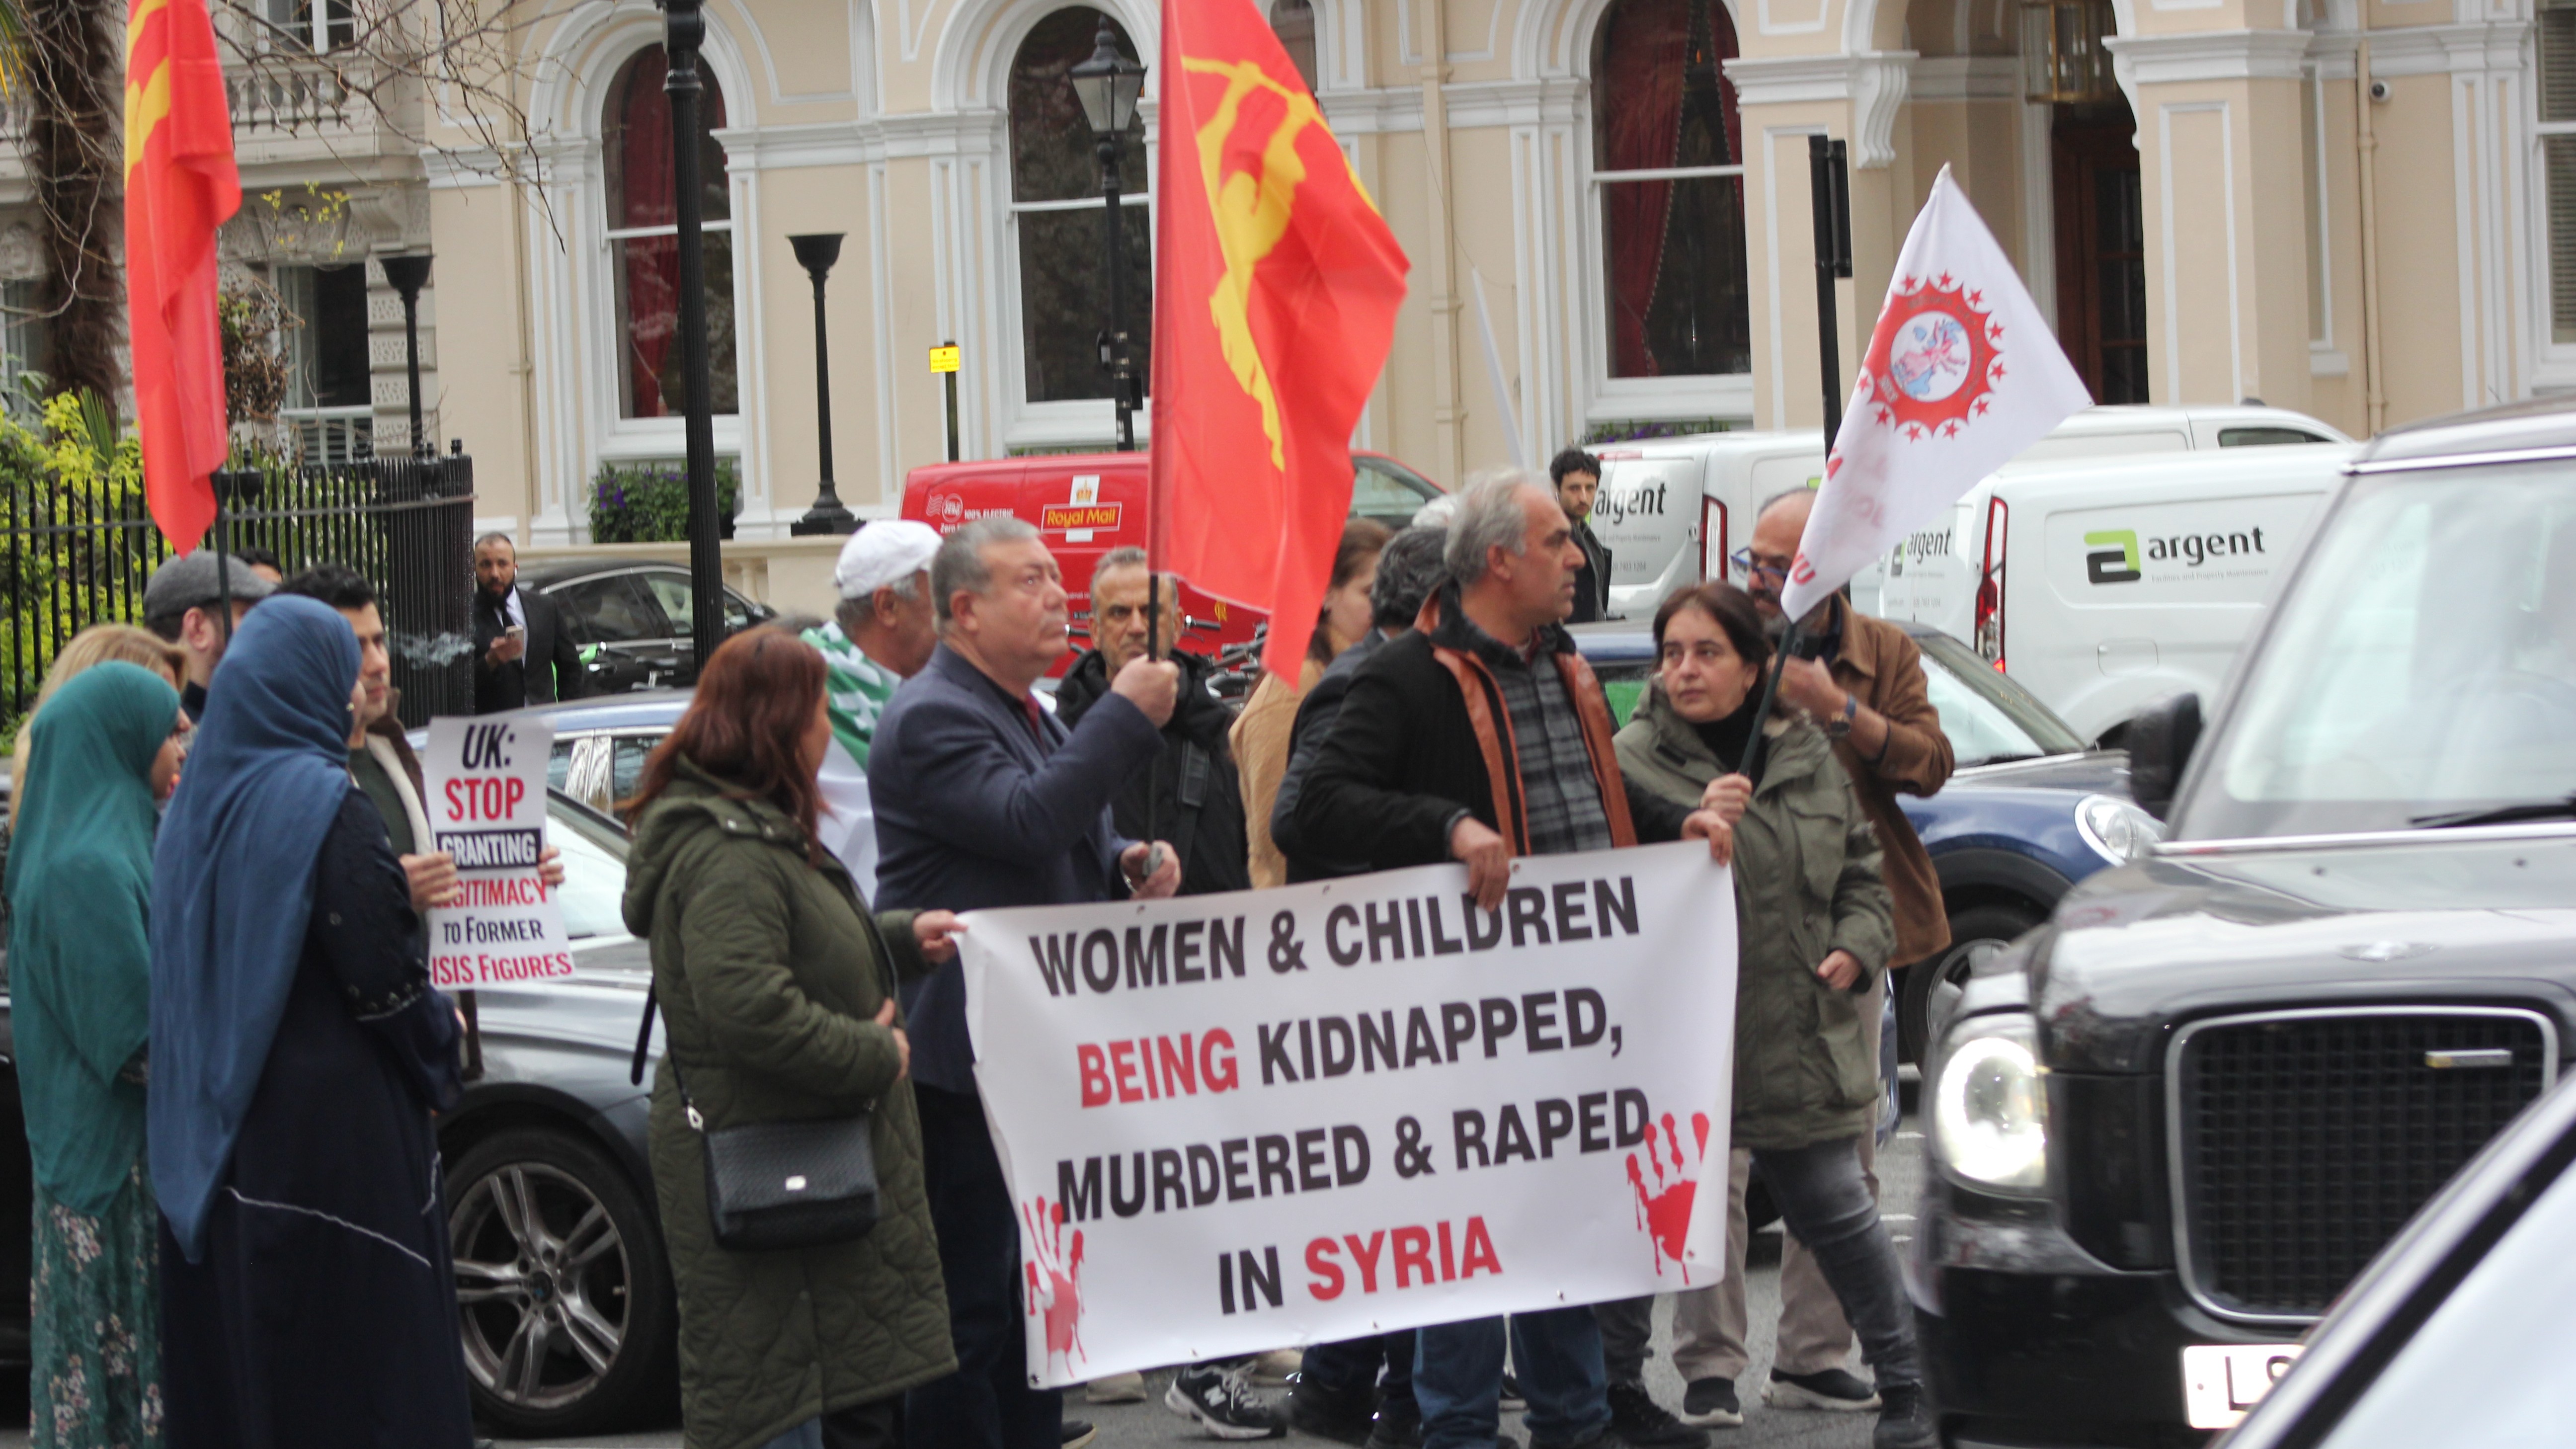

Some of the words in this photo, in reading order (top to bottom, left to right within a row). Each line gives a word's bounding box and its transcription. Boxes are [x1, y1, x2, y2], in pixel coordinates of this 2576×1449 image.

[965, 508, 981, 520] 100%
[983, 508, 1014, 519] ELECTRIC
[1047, 508, 1084, 528] Royal
[1086, 507, 1116, 526] Mail
[1595, 482, 1666, 525] argent
[1907, 527, 1951, 564] argent
[2148, 525, 2266, 566] argent
[2195, 570, 2224, 580] Property
[2226, 567, 2269, 578] Maintenance
[461, 723, 516, 770] UK:
[445, 777, 524, 821] STOP
[1029, 916, 1245, 996] WOMEN
[1268, 910, 1307, 973] &
[1325, 877, 1639, 967] CHILDREN
[432, 955, 475, 984] ISIS
[478, 952, 572, 982] FIGURES
[1078, 1028, 1238, 1108] BEING
[1258, 987, 1622, 1085] KIDNAPPED,
[1057, 1124, 1371, 1224] MURDERED
[1394, 1116, 1435, 1179] &
[1453, 1087, 1650, 1171] RAPED
[1219, 1246, 1283, 1315] IN
[1305, 1216, 1503, 1301] SYRIA
